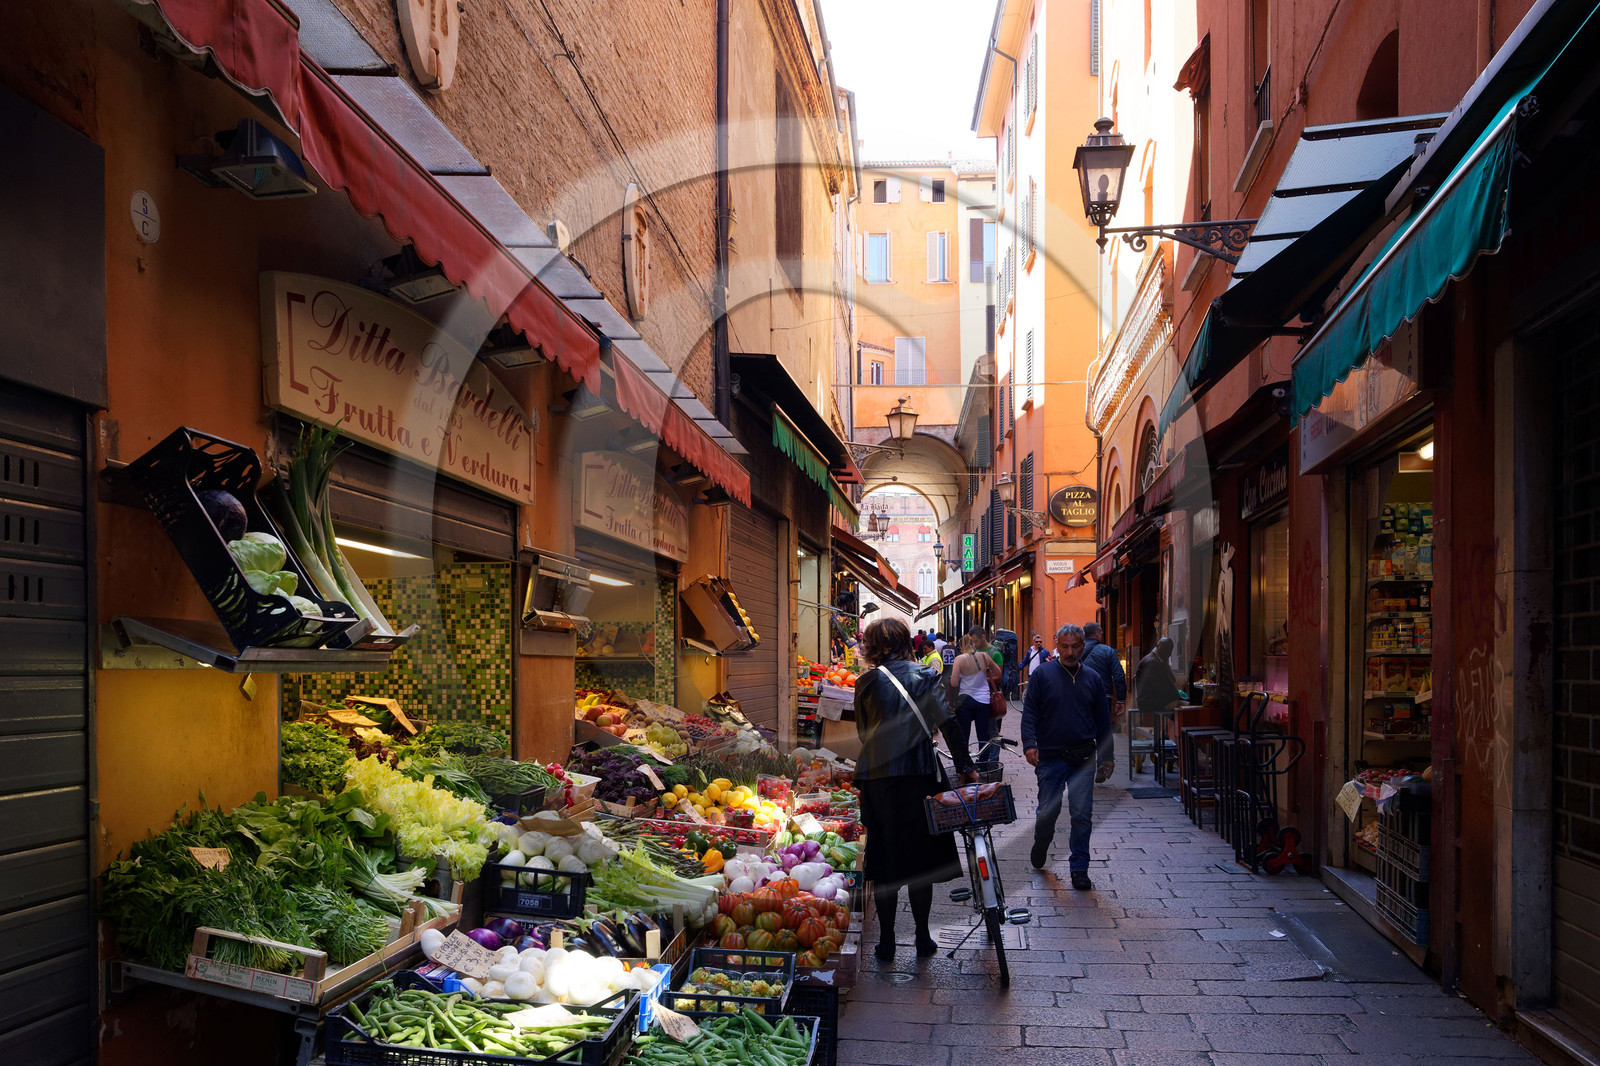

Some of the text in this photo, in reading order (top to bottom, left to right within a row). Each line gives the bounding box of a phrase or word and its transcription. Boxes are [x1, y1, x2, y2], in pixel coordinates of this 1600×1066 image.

[307, 290, 527, 452] Ditta Bardelli
[413, 390, 464, 430] dal 1863
[309, 365, 521, 494] Frutta e Verdura
[605, 463, 637, 500] Ditta
[1065, 491, 1092, 499] PIZZA
[604, 505, 637, 540] Frutta
[1060, 508, 1096, 516] TAGLIO
[520, 898, 540, 907] 7058
